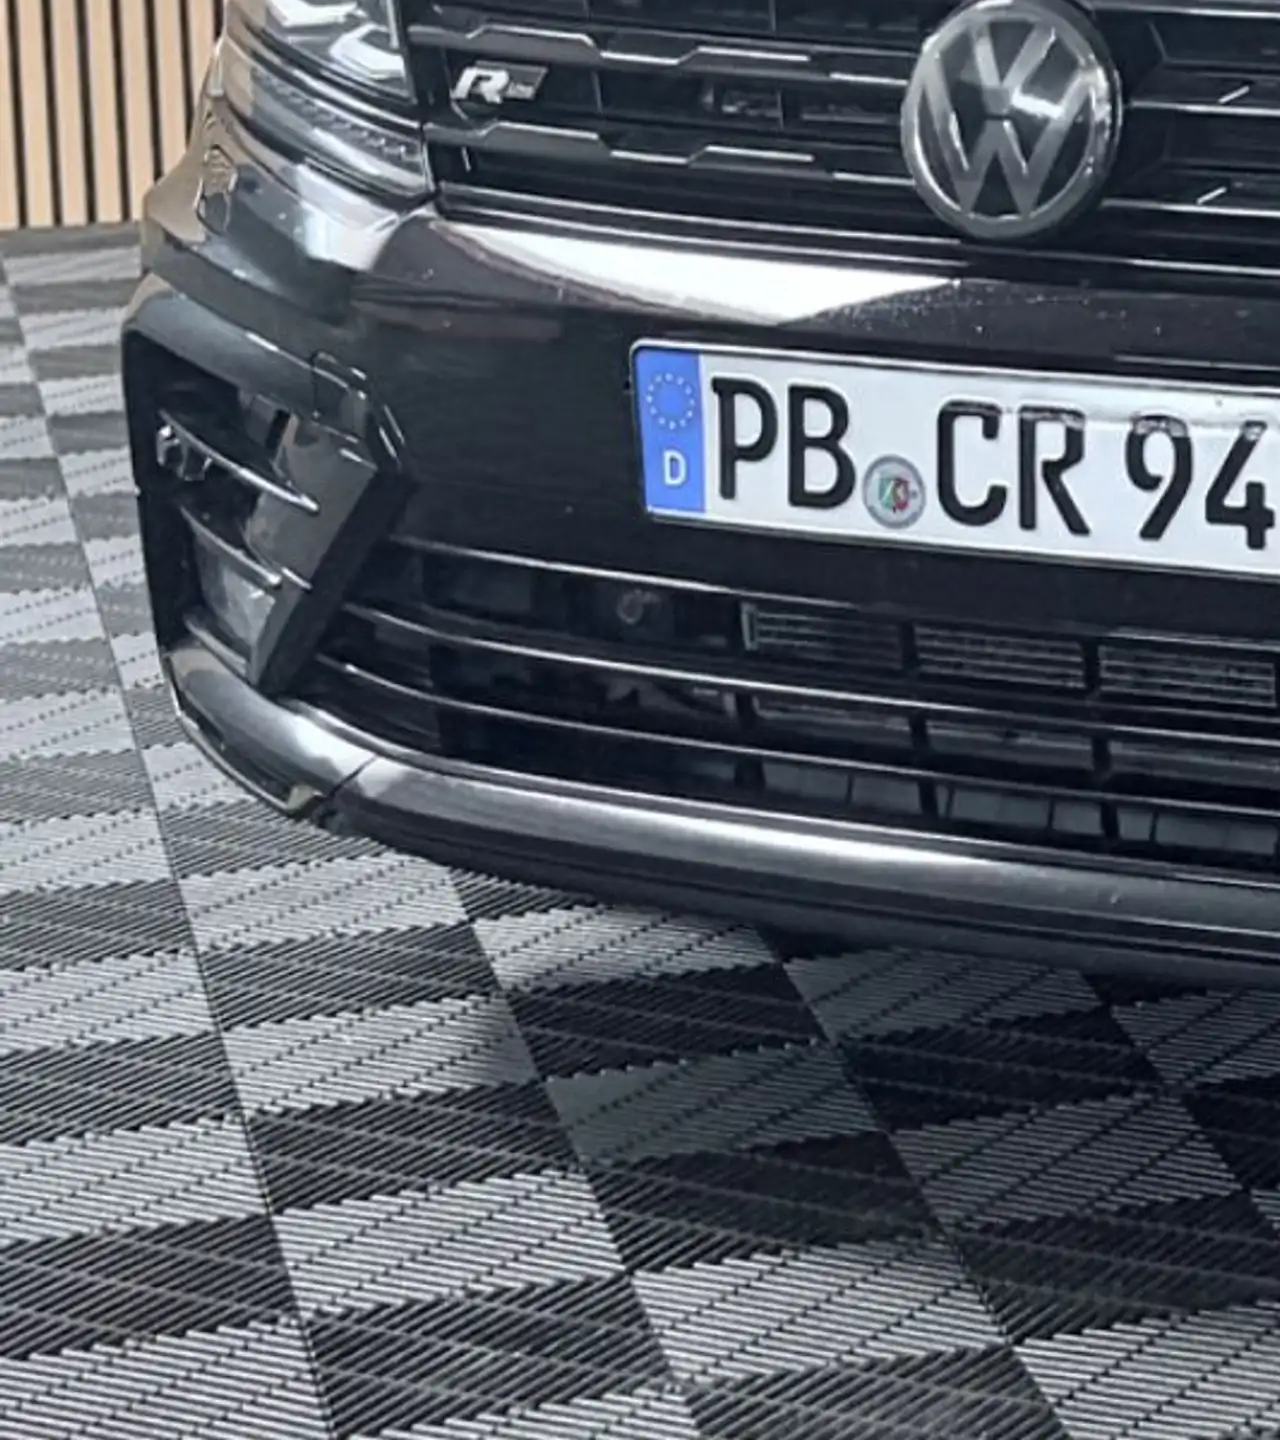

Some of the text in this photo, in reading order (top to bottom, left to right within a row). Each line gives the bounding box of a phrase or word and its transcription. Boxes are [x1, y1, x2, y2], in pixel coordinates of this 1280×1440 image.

[908, 0, 1107, 230] VW
[663, 449, 687, 486] D
[711, 376, 1276, 550] PB CR 94
